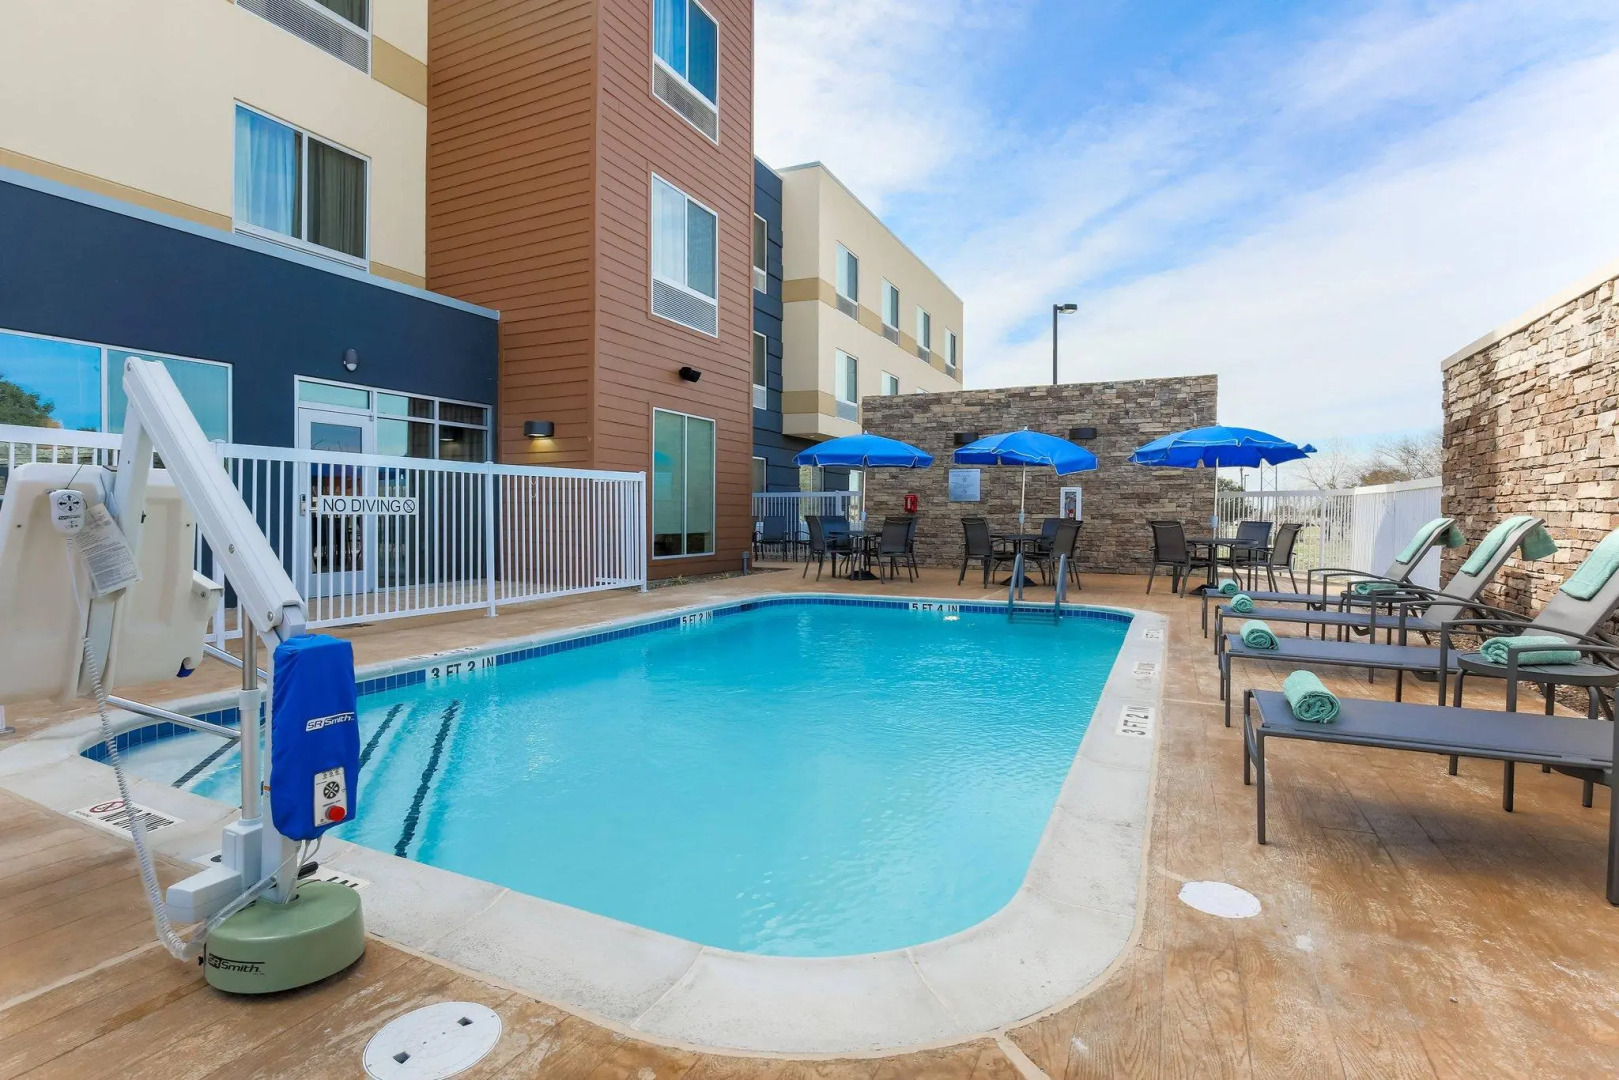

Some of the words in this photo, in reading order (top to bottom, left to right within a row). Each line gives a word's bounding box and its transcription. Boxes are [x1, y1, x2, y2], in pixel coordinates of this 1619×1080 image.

[323, 499, 346, 512] NO
[351, 499, 401, 512] DIVING
[431, 667, 440, 678] 3
[446, 663, 461, 676] FT
[467, 661, 476, 671] 2
[482, 656, 494, 668] IN
